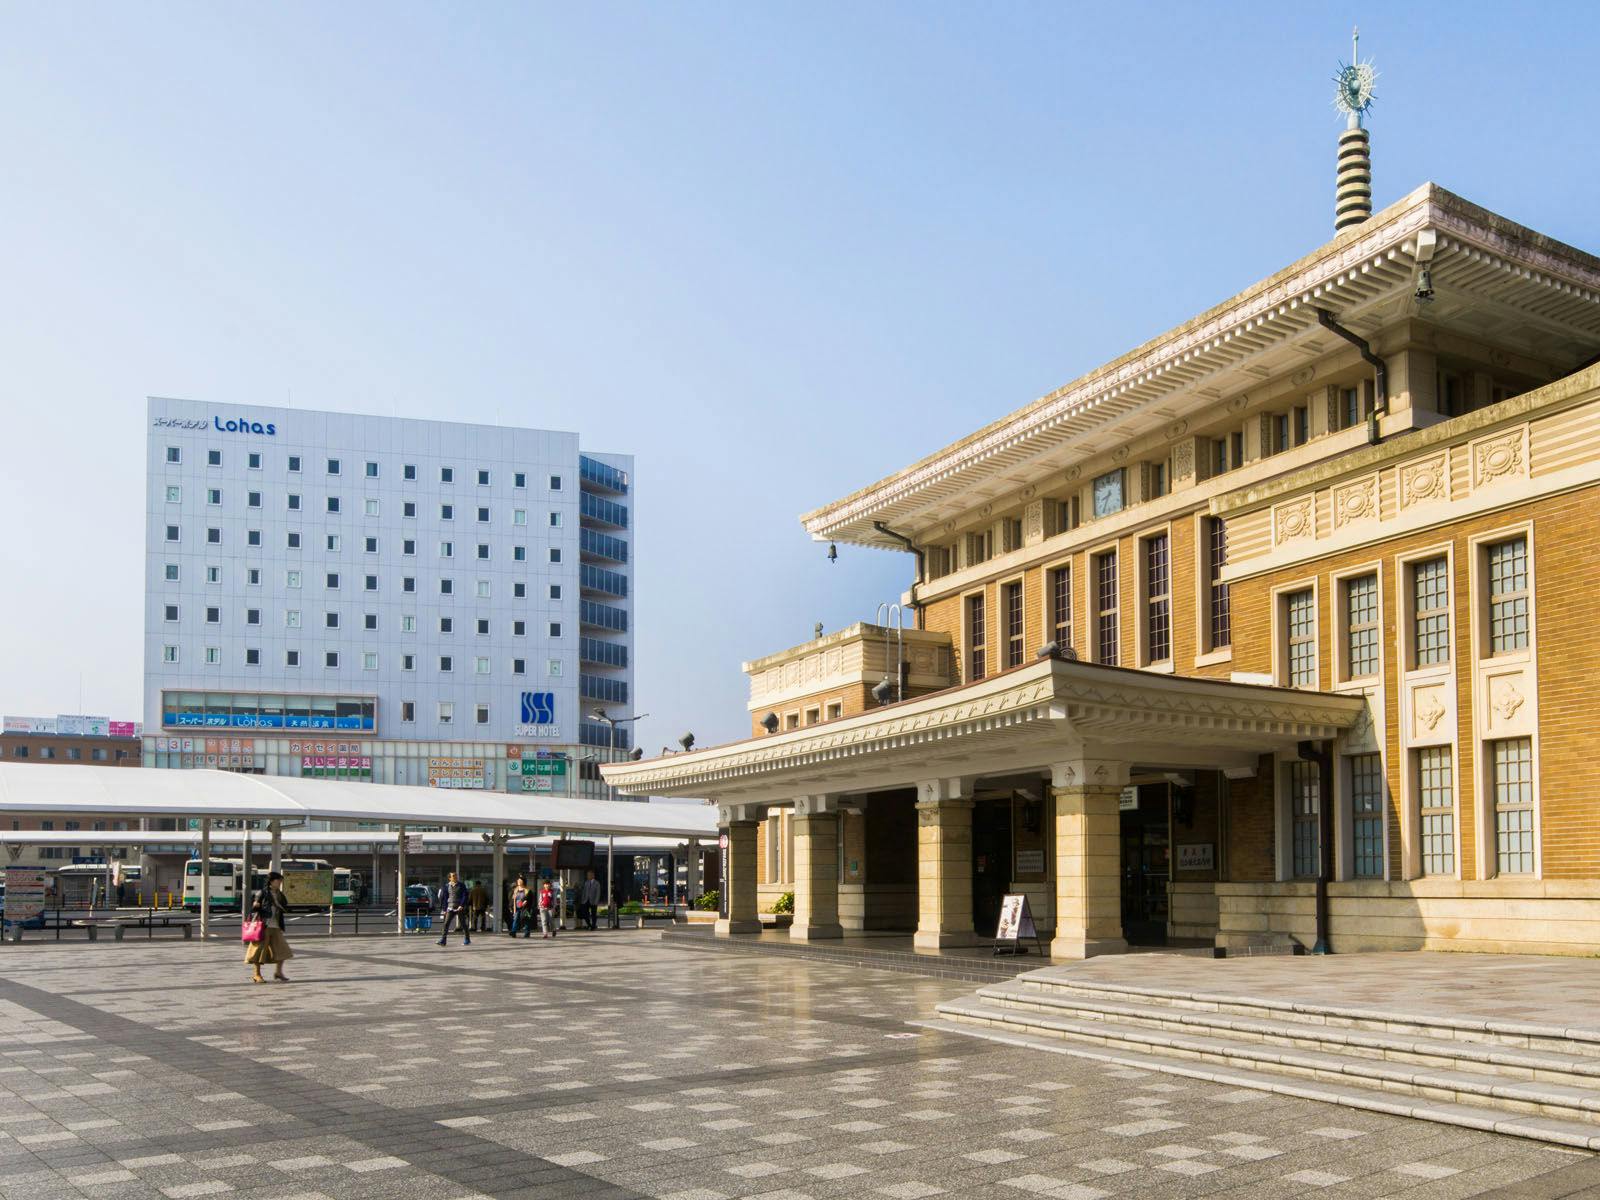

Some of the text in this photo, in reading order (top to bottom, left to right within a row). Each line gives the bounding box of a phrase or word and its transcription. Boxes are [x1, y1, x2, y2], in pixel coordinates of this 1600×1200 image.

[215, 416, 275, 435] Lohas
[237, 715, 273, 727] Lohas
[514, 725, 560, 737] SUPER HOTEL
[291, 743, 360, 753] カイセイ薬局
